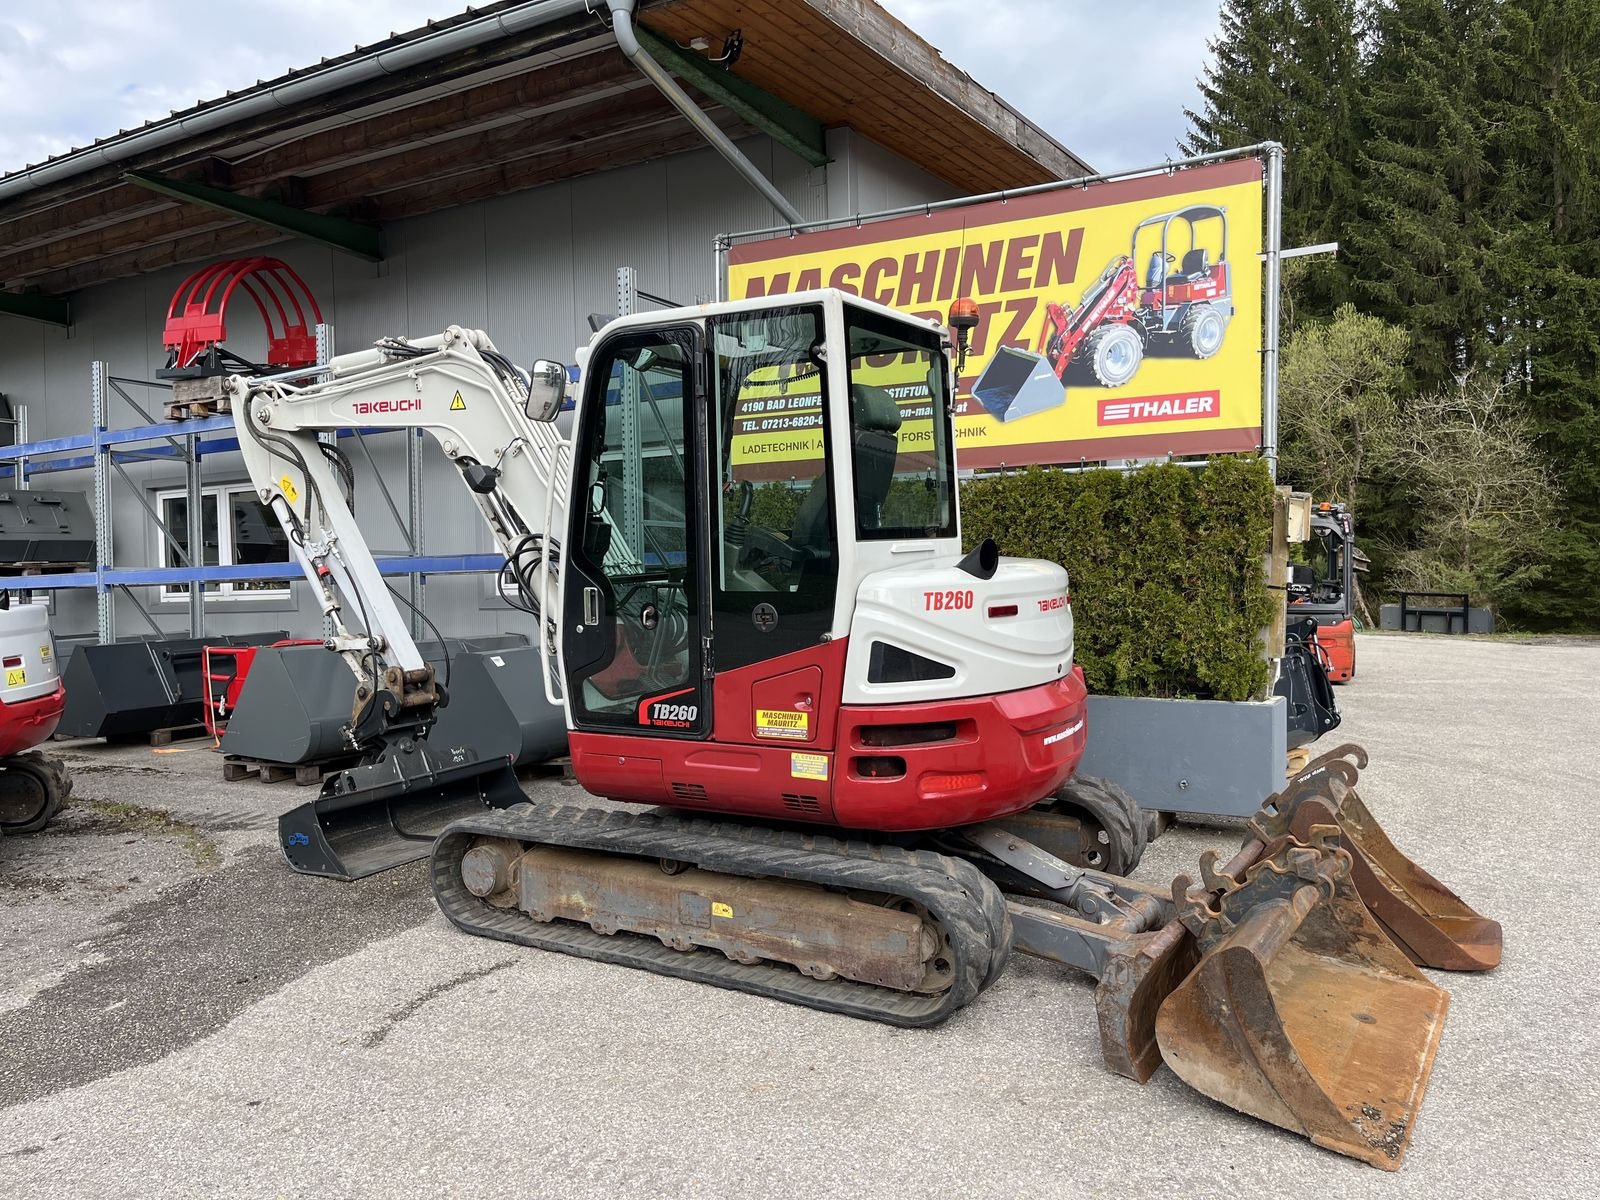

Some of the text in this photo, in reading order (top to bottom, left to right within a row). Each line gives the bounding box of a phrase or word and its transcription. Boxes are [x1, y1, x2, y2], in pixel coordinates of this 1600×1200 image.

[741, 385, 929, 413] 4190 BAD LEONFE STIFTUN
[1130, 397, 1214, 418] THALER
[742, 421, 760, 431] TEL.
[742, 441, 810, 454] LADETECHNIK
[924, 590, 974, 611] TB260
[653, 703, 698, 721] TB260
[762, 711, 803, 721] MASCHINEN
[767, 718, 798, 728] MAURITZ
